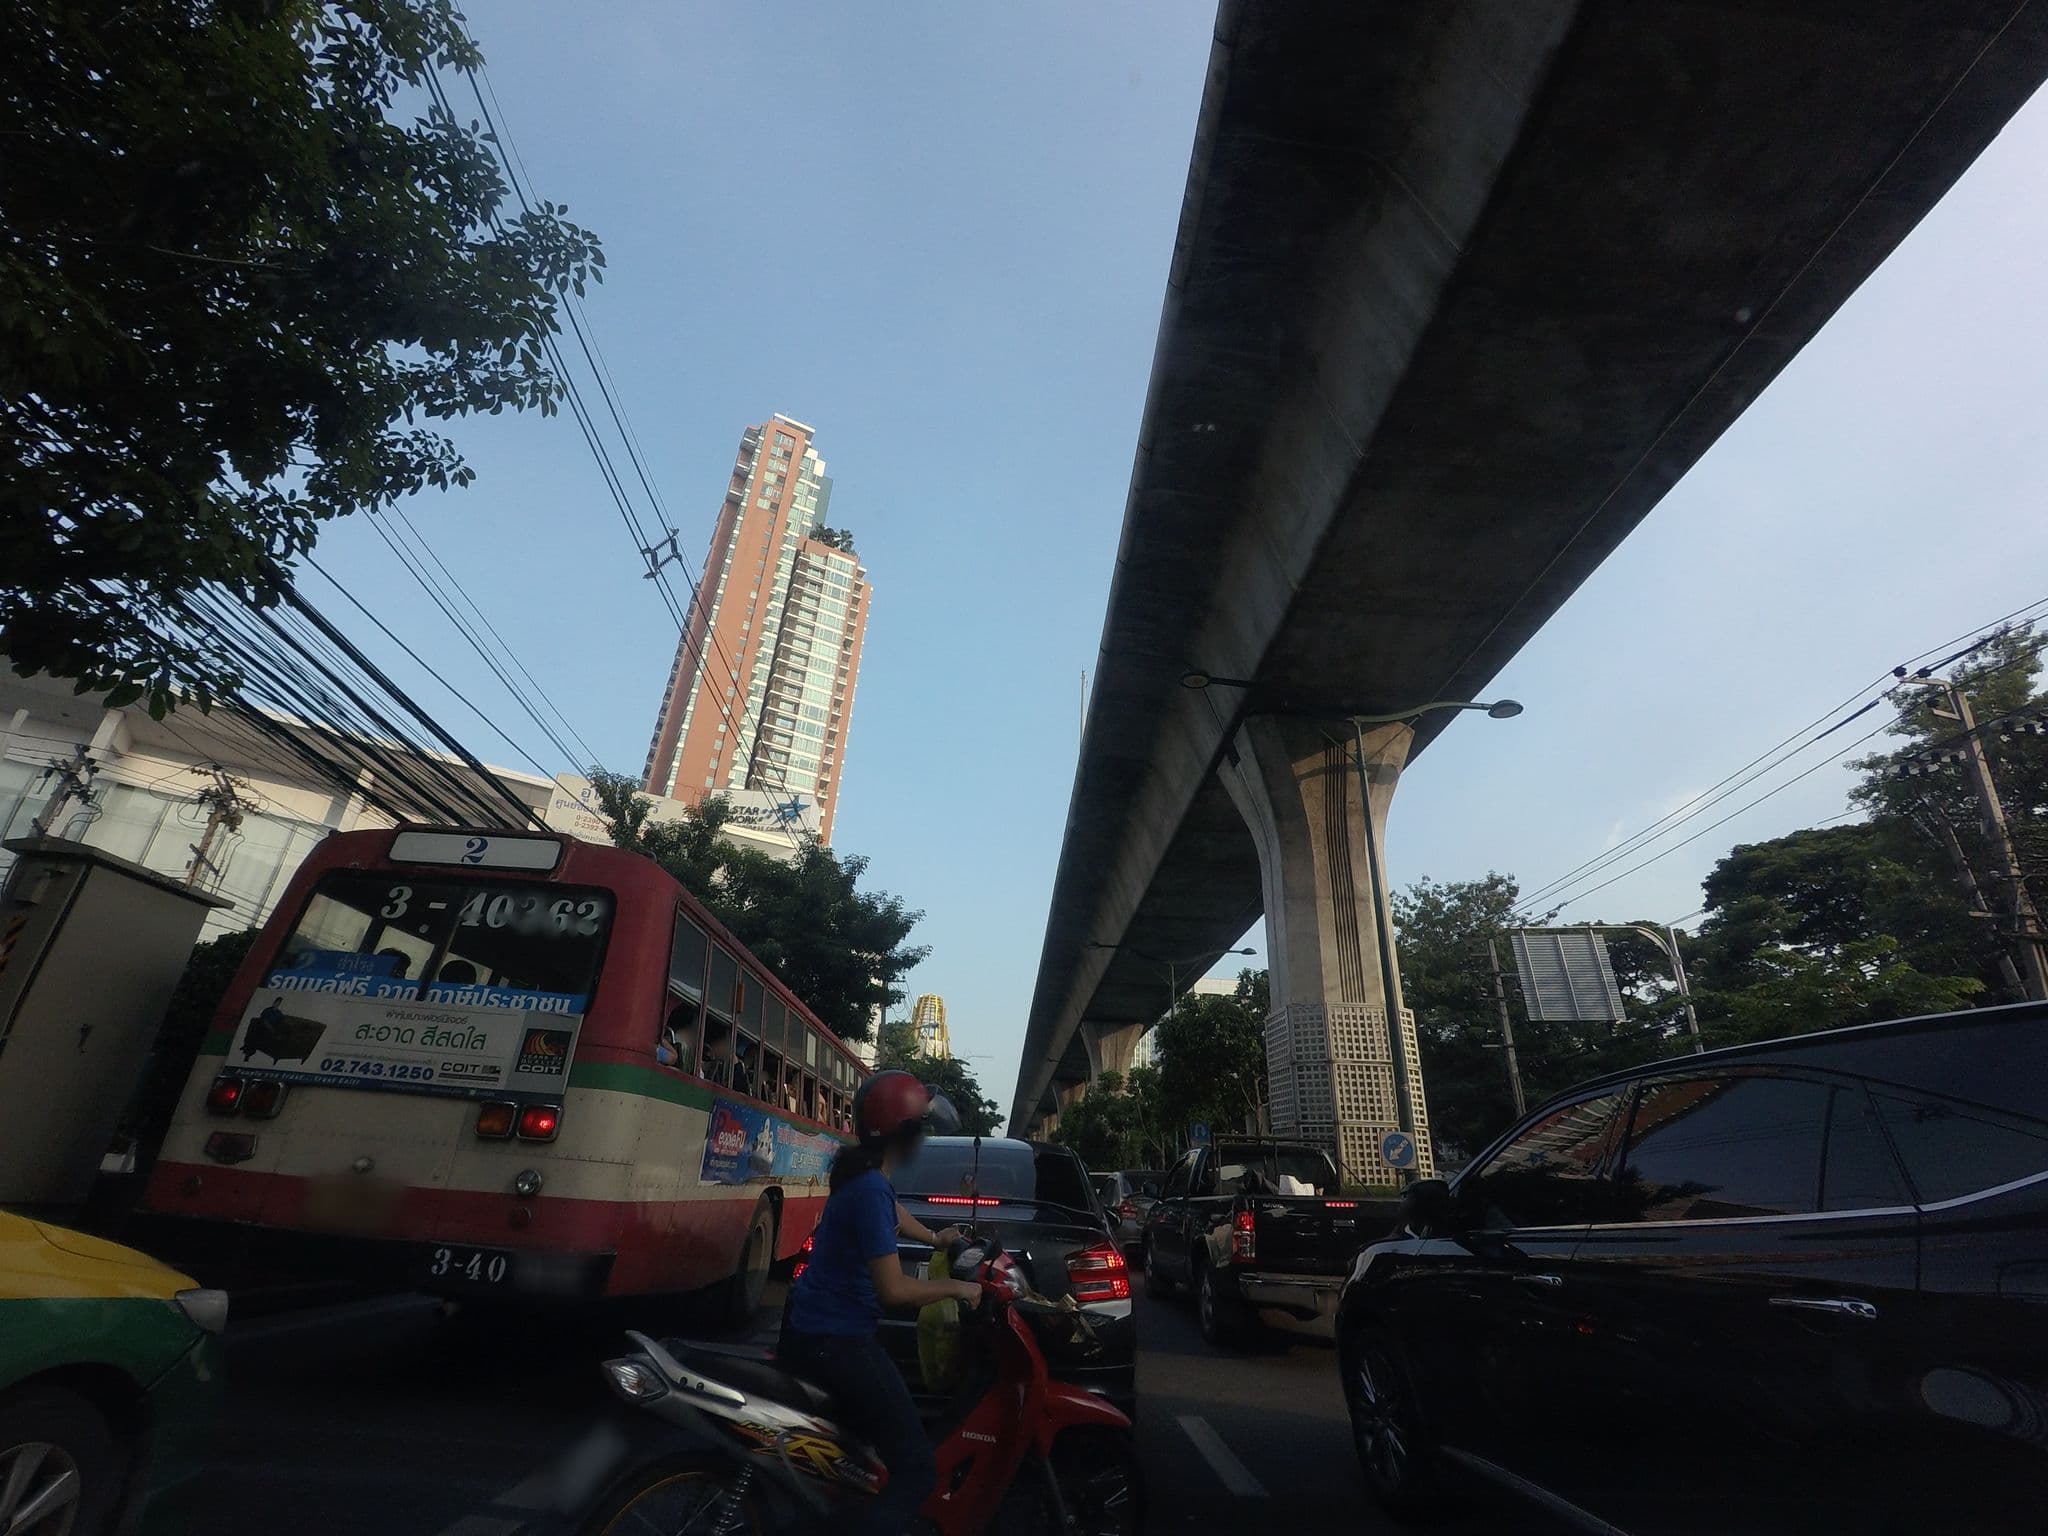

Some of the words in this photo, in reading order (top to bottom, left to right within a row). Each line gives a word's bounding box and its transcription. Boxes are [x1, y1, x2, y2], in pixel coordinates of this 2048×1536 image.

[461, 837, 489, 864] 2
[354, 1022, 415, 1047] สะอาด
[421, 1022, 489, 1051] สีสดใส
[320, 1057, 434, 1082] 02.743.1250
[440, 1062, 480, 1074] COIT
[518, 1064, 561, 1075] COIT
[961, 1431, 998, 1445] HONDA
